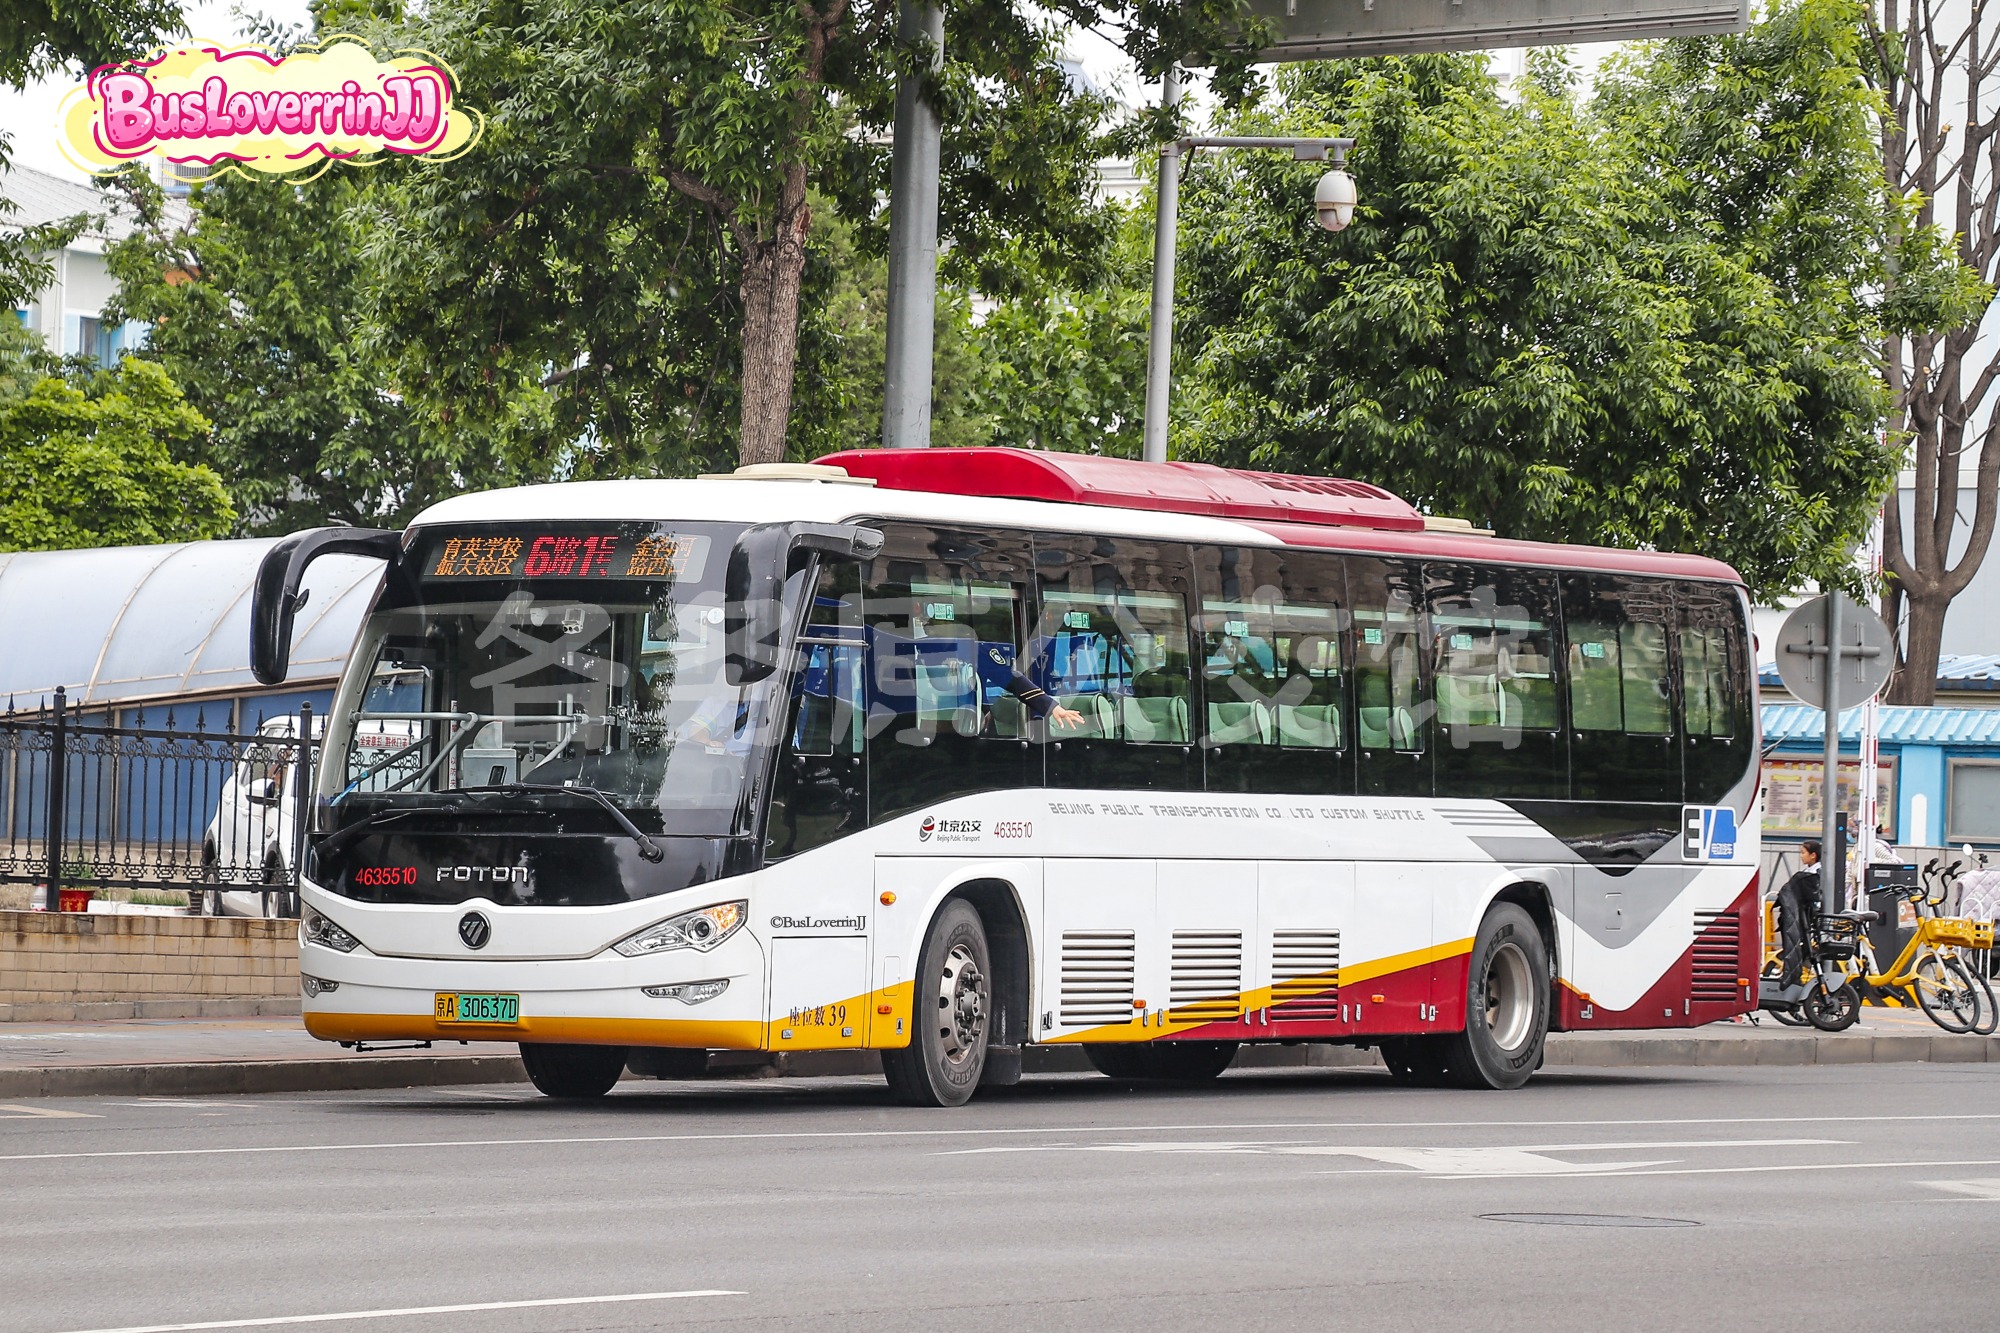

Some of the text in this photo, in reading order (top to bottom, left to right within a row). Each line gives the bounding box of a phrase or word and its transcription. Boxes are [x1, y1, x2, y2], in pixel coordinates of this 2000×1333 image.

[445, 537, 524, 559] 育英学校
[434, 557, 517, 576] 航天校区
[1049, 803, 1095, 815] BEIJING
[1100, 804, 1144, 816] PUBLIC
[1149, 805, 1260, 818] TRANSPORTATION
[1320, 808, 1369, 820] CUSTOM
[1372, 809, 1426, 821] SHUTTLE
[938, 820, 982, 833] 北京公交
[993, 821, 1033, 838] 4635510
[937, 834, 949, 843] Beijing
[962, 834, 980, 843] Transport
[355, 867, 417, 885] 4635510
[436, 866, 528, 883] FOTON
